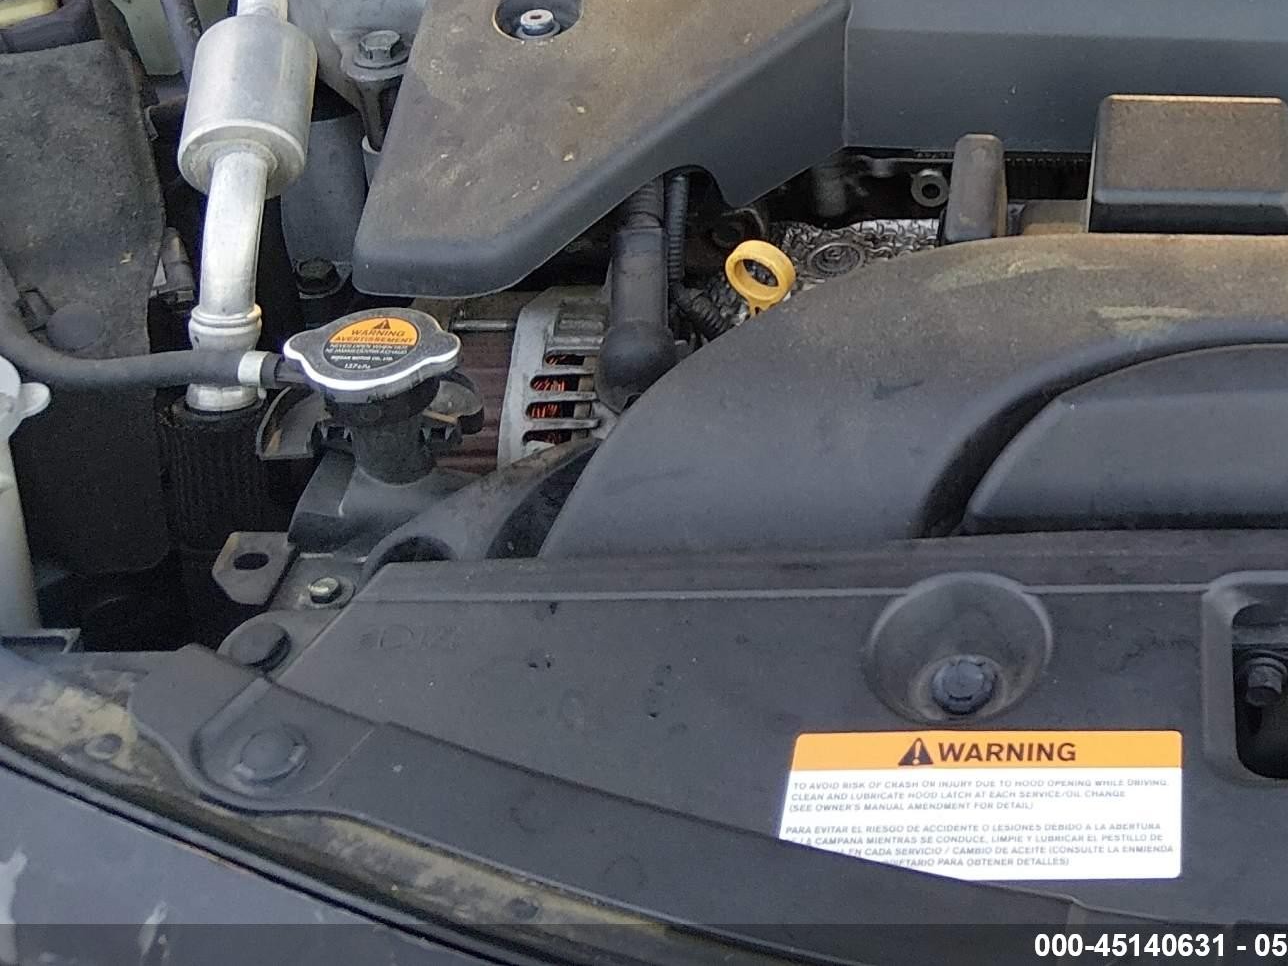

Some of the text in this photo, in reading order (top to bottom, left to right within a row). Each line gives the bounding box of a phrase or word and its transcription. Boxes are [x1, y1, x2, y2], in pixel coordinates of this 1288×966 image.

[352, 329, 406, 337] WARNING
[938, 742, 1077, 762] WARNING
[794, 782, 807, 790] TO
[809, 781, 840, 790] AVOID
[843, 781, 865, 790] RISK
[869, 781, 881, 789] OF
[885, 781, 919, 789] CRASH
[922, 780, 936, 789] OR
[939, 780, 972, 789] INJURY
[976, 780, 996, 788] DUE
[1000, 780, 1012, 788] TO
[1015, 779, 1045, 788] HOOD
[1048, 779, 1092, 788] OPENING
[1095, 779, 1124, 787] WHILE
[792, 792, 824, 801] CLEAN
[827, 792, 848, 801] AND
[851, 792, 904, 800] LUBRICATE
[908, 791, 938, 800] HOOD
[941, 791, 972, 799] LATCH
[975, 791, 986, 799] AT
[990, 791, 1016, 799] EACH
[1085, 790, 1126, 798] CHANGE
[789, 801, 1034, 813] (SEE OWNER'S MANUAL AMENDMENT FOR DETAIL)
[786, 826, 812, 834] PARA
[815, 825, 849, 834] EVITAR
[852, 825, 863, 833] EL
[866, 825, 904, 833] RIESGO
[907, 824, 920, 833] DE
[923, 824, 979, 833] ACCIDENTE
[993, 823, 1042, 832] LESIONES
[1045, 823, 1083, 832] DEBIDO
[1095, 823, 1107, 831] LA
[1109, 822, 1161, 831] ABERTURA
[815, 837, 864, 845] CAMPANA
[867, 836, 918, 845] MIENTRAS
[921, 836, 933, 844] SE
[992, 835, 1024, 843] LIMPIE
[1036, 835, 1085, 843] LUBRICAR
[1088, 834, 1098, 842] EL
[1102, 834, 1148, 842] PESTILLO
[1151, 834, 1164, 842] DE
[865, 848, 892, 856] CADA
[896, 848, 943, 856] SERVICIO
[952, 847, 993, 855] CAMBIO
[996, 847, 1009, 855] DE
[1011, 846, 1047, 855] ACEITE
[1049, 846, 1105, 854] (CONSULTE
[1108, 845, 1119, 853] LA
[1123, 845, 1174, 853] ENMIENDA
[938, 858, 964, 867] PARA
[967, 858, 1014, 866] OBTENER
[1017, 857, 1070, 866] DETALLES)
